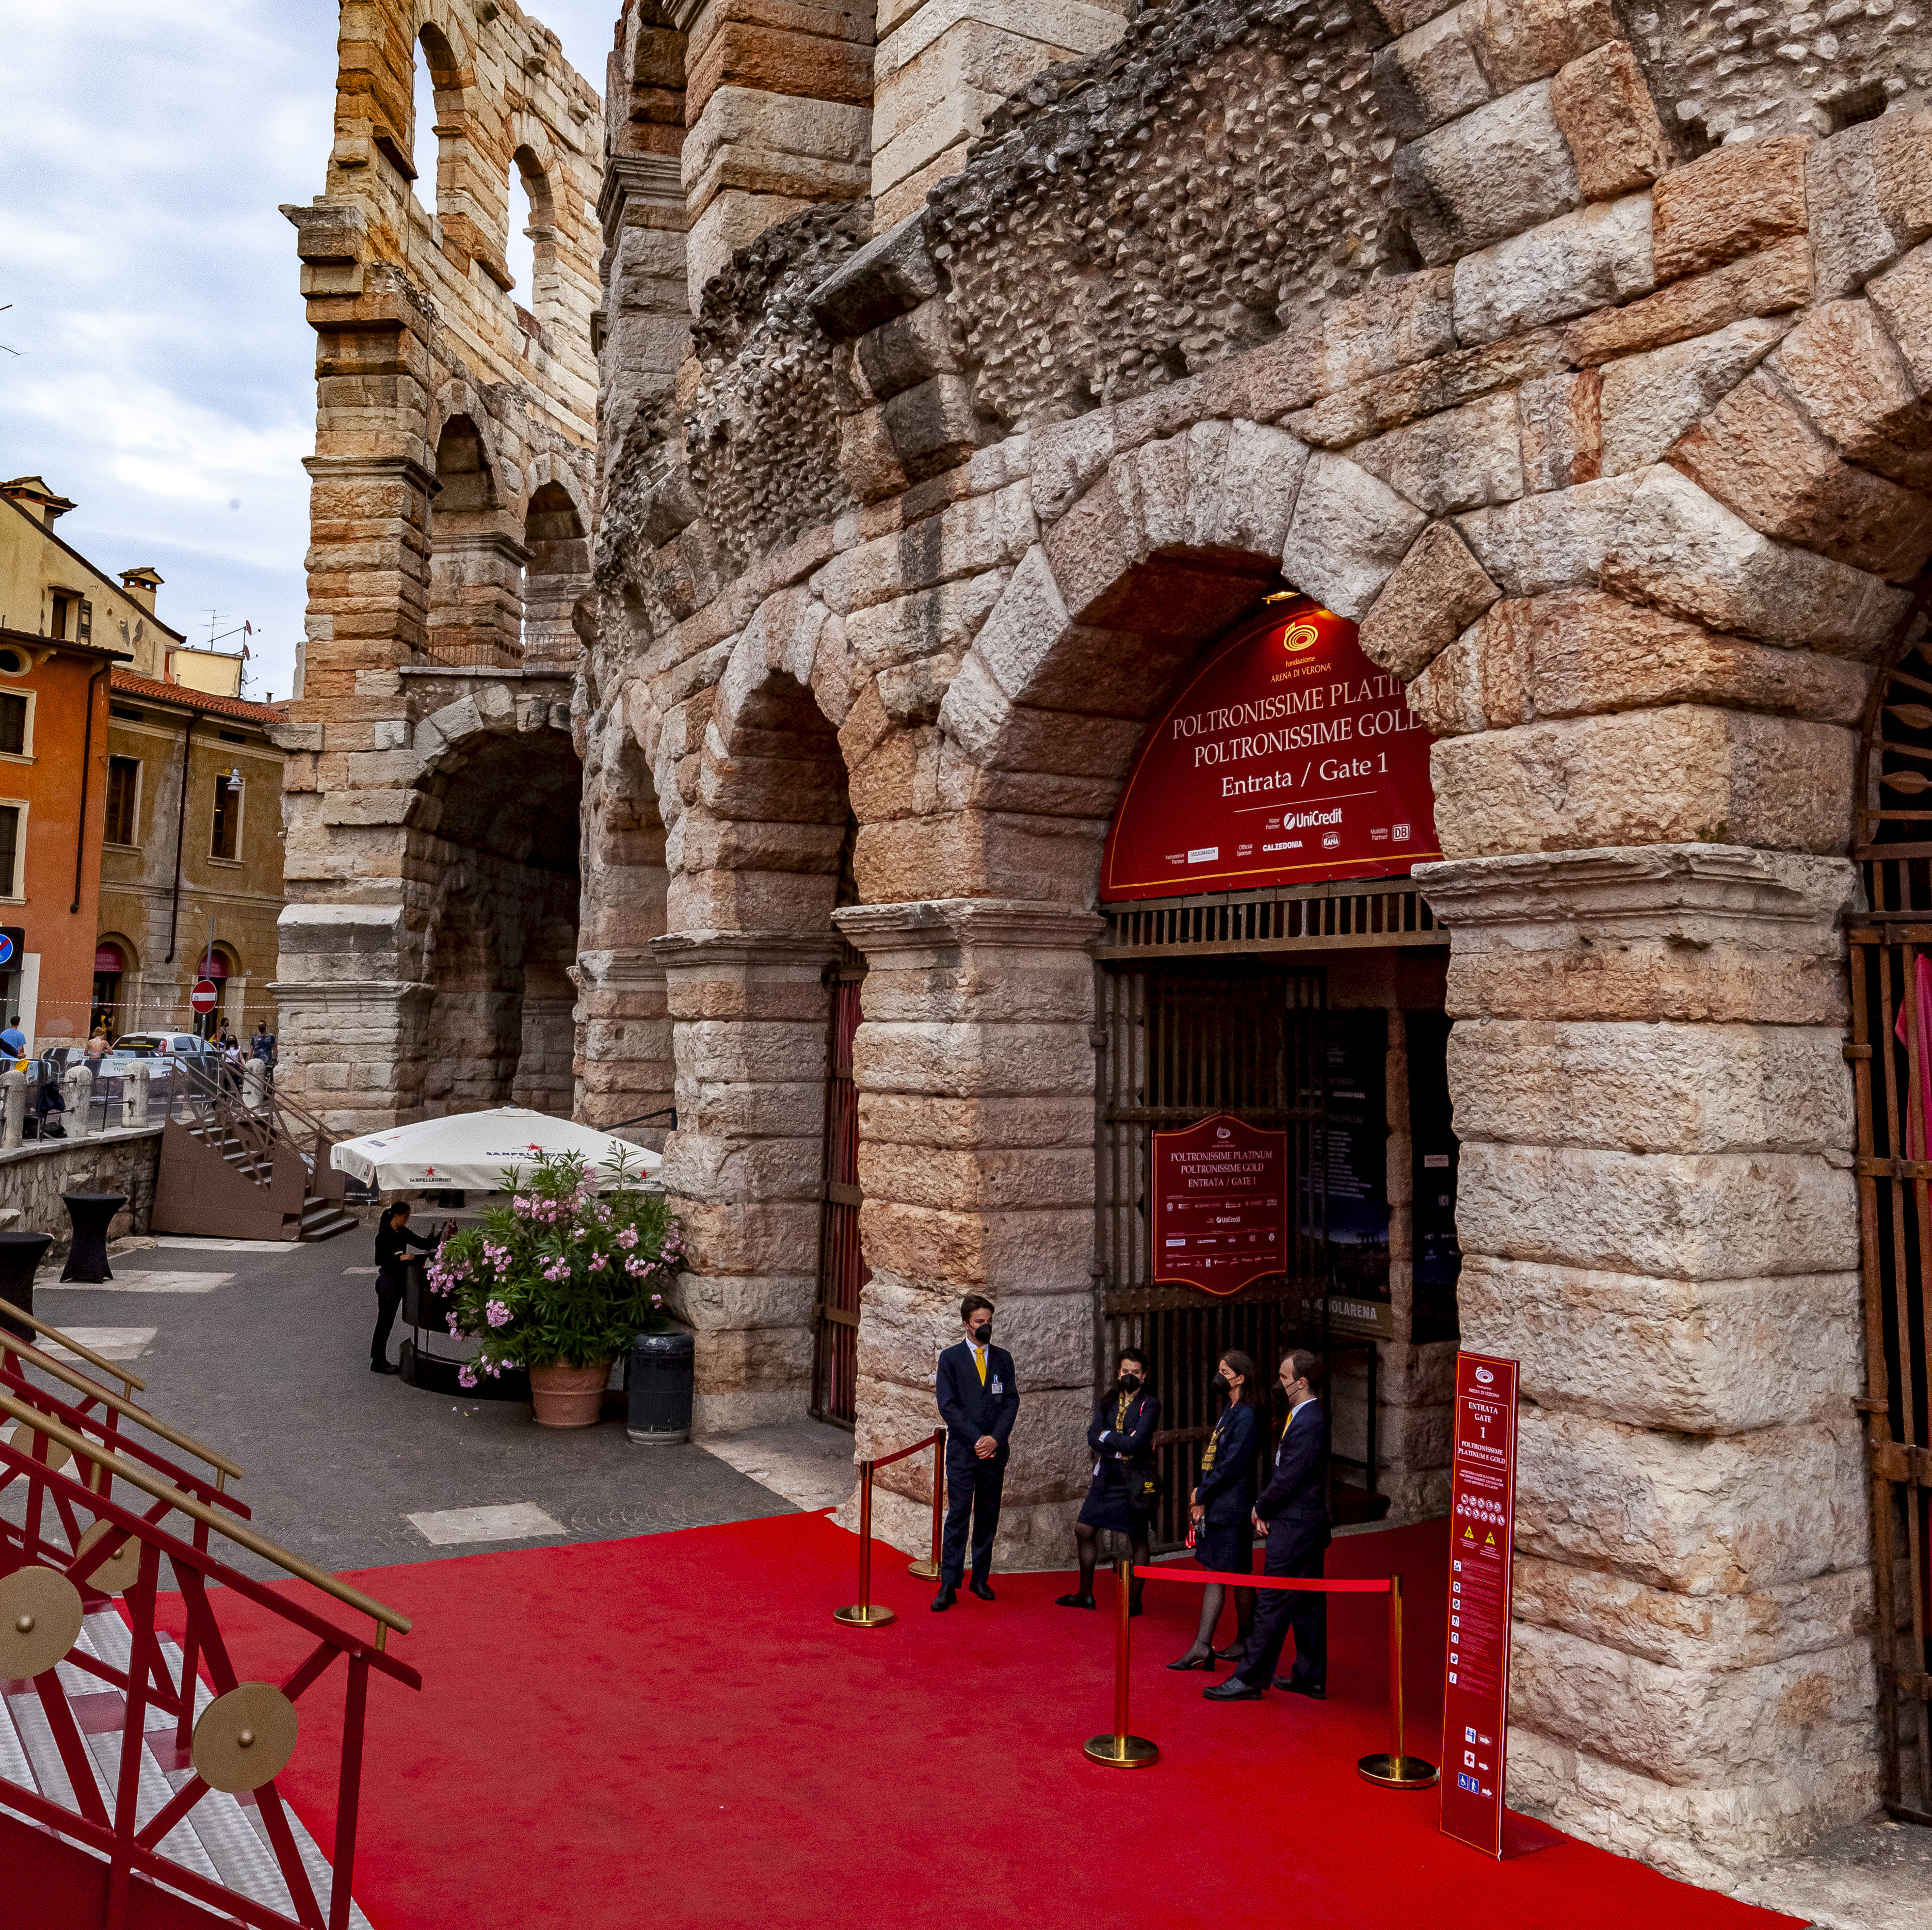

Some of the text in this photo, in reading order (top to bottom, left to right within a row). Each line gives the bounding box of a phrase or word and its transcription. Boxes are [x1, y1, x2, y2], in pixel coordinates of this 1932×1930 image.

[1285, 656, 1315, 668] fondazione
[1270, 662, 1331, 684] ARENA DI VERONA
[1172, 687, 1324, 740] POLTRONISSIME
[1194, 717, 1353, 768] POLTRONISSIME
[1221, 751, 1388, 797] Entrata / Gate 1
[1296, 807, 1342, 828] UniCredit
[1395, 827, 1407, 838] DB
[1262, 840, 1303, 852] CALZEDONIA
[1323, 838, 1339, 846] RANA
[1190, 849, 1216, 857] VOLKSWAGEN
[1171, 1150, 1273, 1162] POLTRONISSIME PLATINUM
[1181, 1163, 1264, 1174] POLTRONISSIME GOLD
[1188, 1178, 1224, 1187] ENTRATA
[1231, 1177, 1251, 1186] GATE
[1468, 1402, 1498, 1415] ENTRATA
[1474, 1413, 1492, 1423] GATE
[1480, 1426, 1486, 1438] 1
[1461, 1440, 1503, 1455] POLTRONISSIME
[1458, 1448, 1485, 1459] PLATINUM
[1490, 1455, 1506, 1464] GOLD
